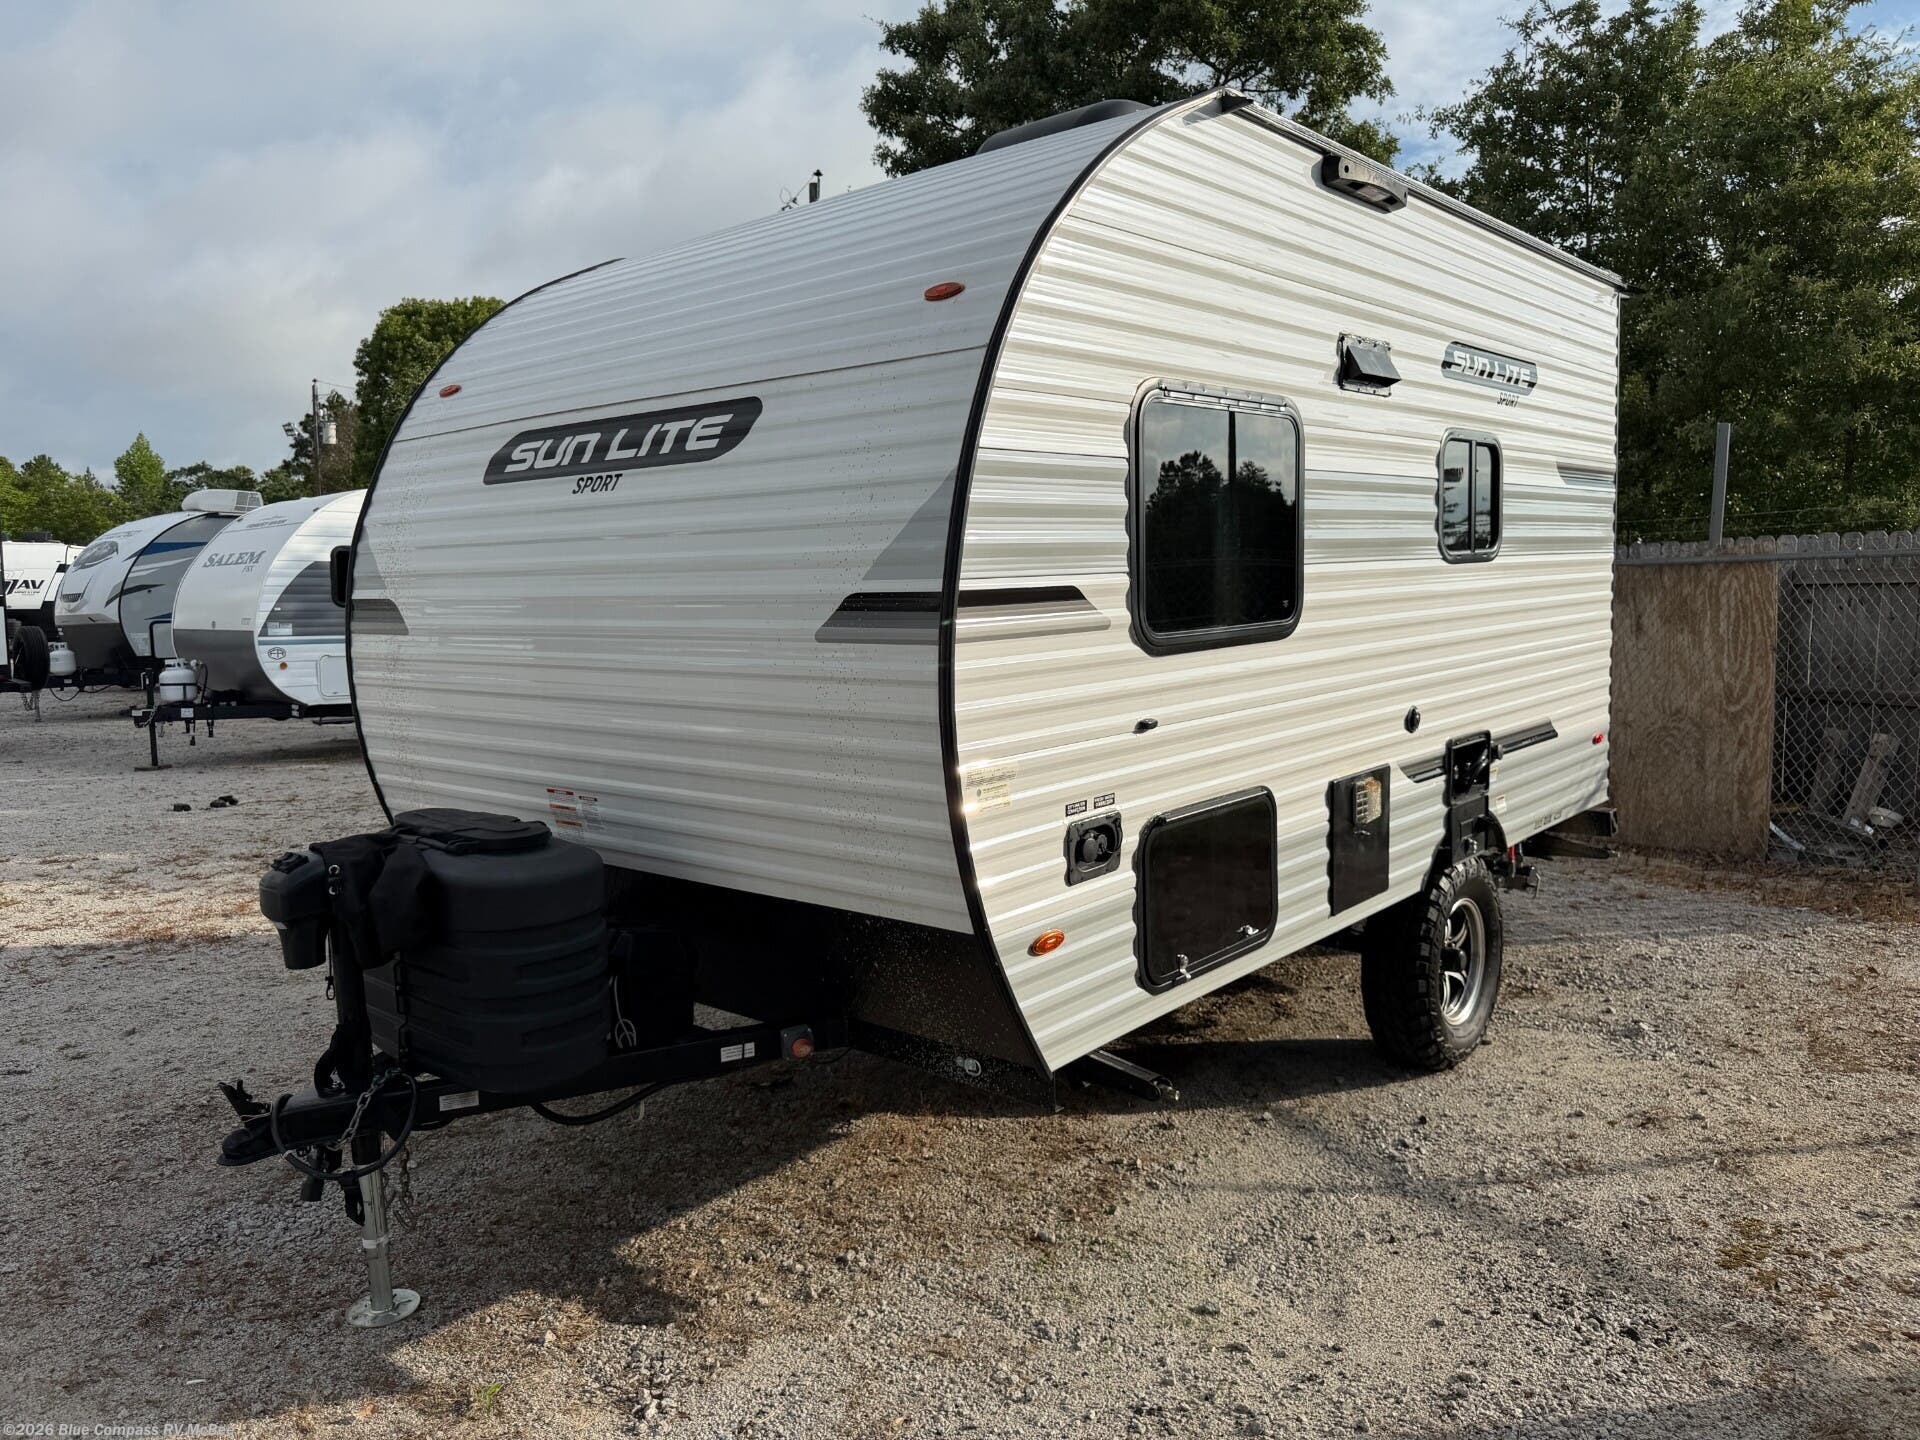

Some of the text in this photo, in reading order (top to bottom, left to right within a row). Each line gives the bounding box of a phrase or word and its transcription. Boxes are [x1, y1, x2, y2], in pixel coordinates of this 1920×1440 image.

[1450, 350, 1531, 388] SUN LITE
[1497, 392, 1519, 408] SPORT
[504, 413, 734, 473] SUN LITE
[572, 474, 623, 495] SPORT
[203, 550, 266, 567] SALEM
